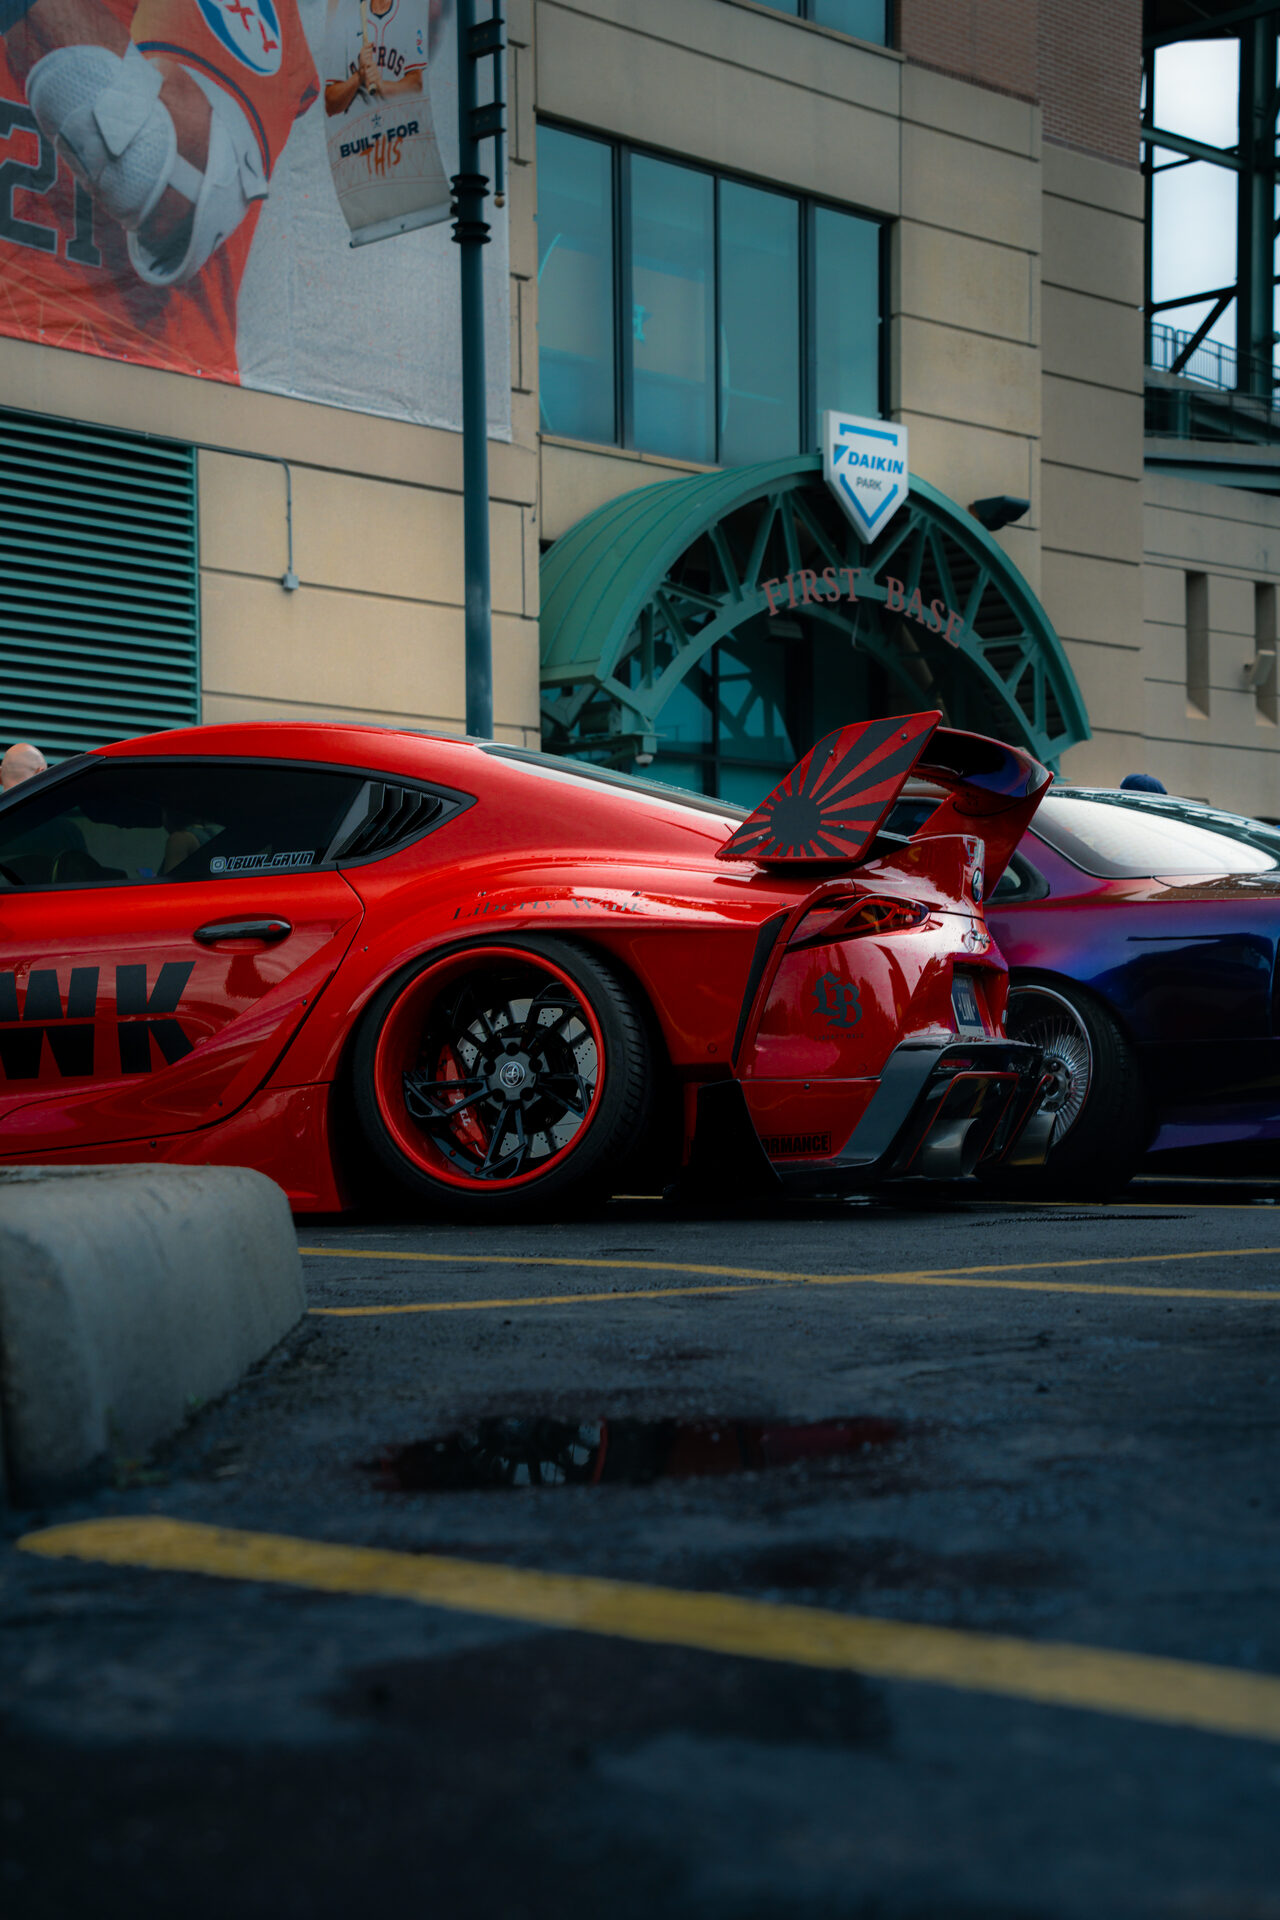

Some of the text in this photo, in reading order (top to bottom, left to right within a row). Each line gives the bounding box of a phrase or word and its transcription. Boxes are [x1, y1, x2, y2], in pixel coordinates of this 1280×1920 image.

[340, 120, 419, 158] BUILT FOR
[359, 133, 403, 176] THIS
[848, 450, 904, 475] DAIKIN
[856, 476, 882, 491] PARK
[761, 567, 964, 648] FIRST BASE
